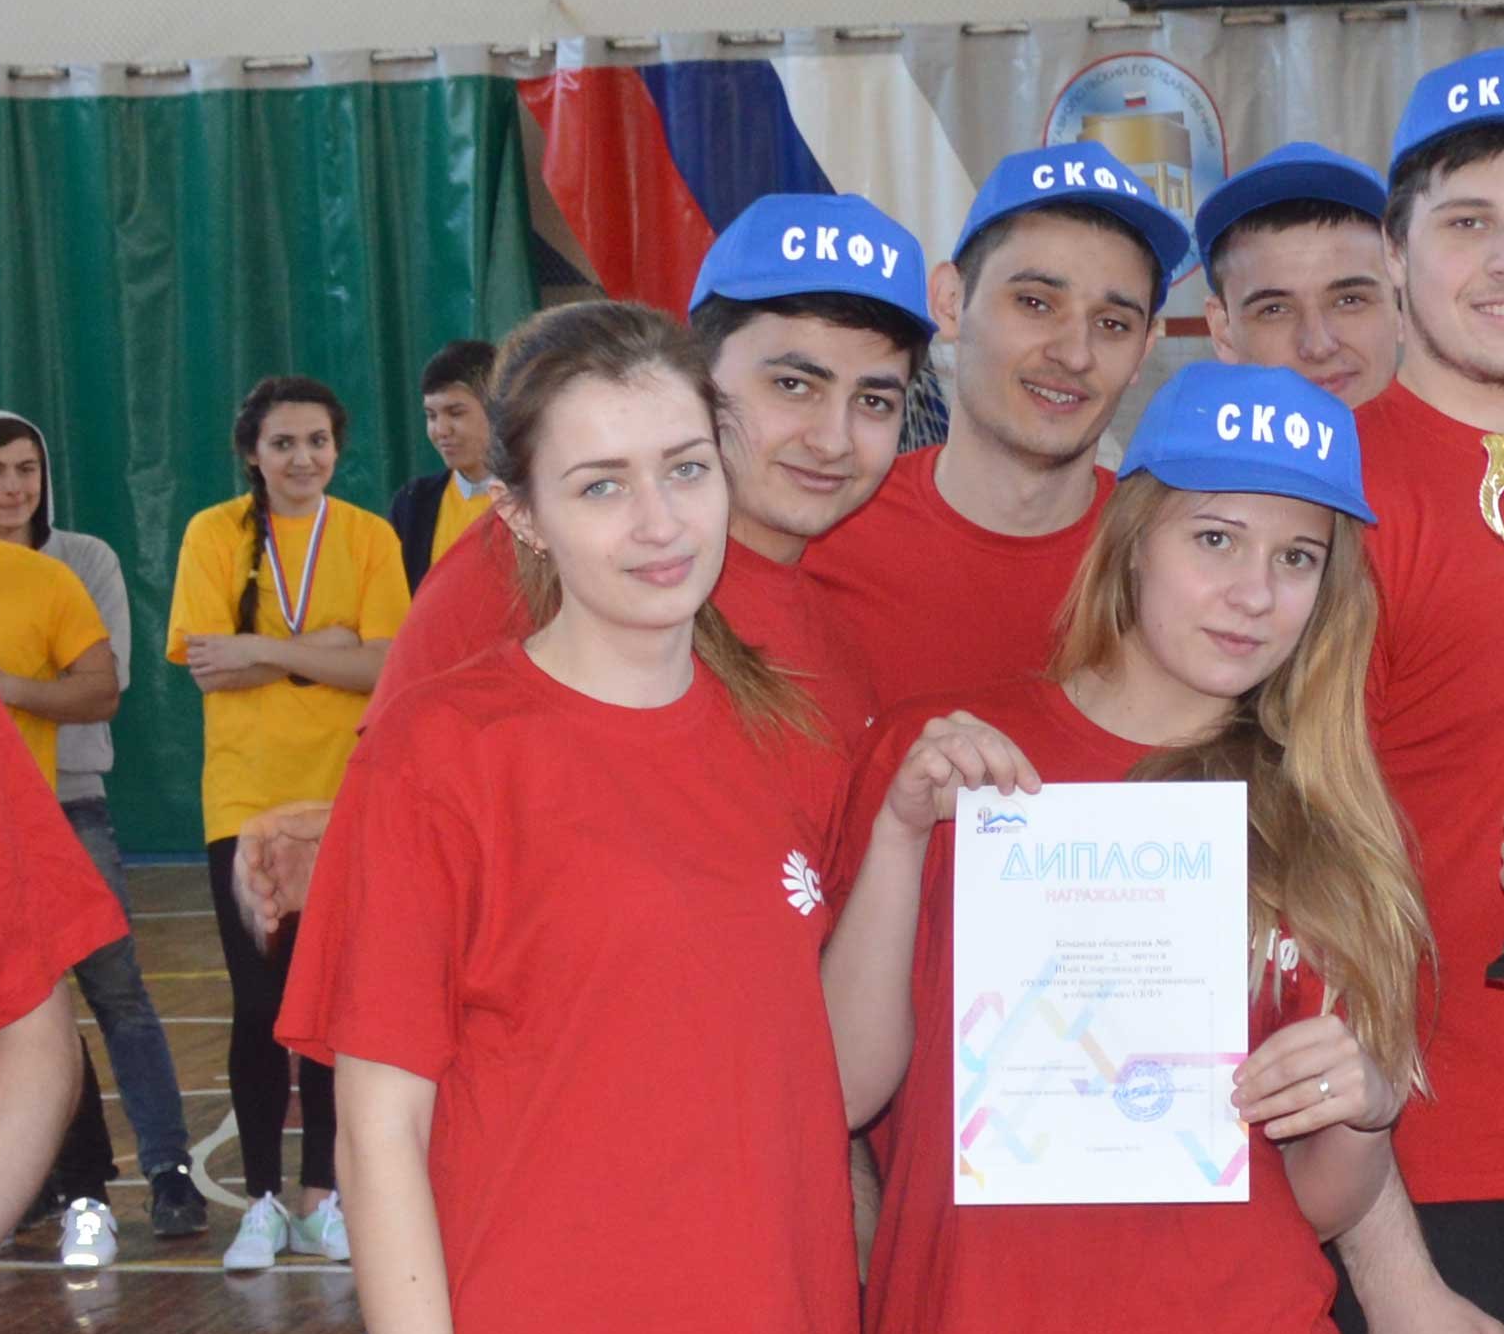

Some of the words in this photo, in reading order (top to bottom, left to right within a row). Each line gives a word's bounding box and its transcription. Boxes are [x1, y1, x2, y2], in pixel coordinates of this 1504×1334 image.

[781, 226, 899, 279] СКФУ
[1216, 403, 1334, 461] СКФУ
[999, 842, 1212, 881] ДИПЛОМ
